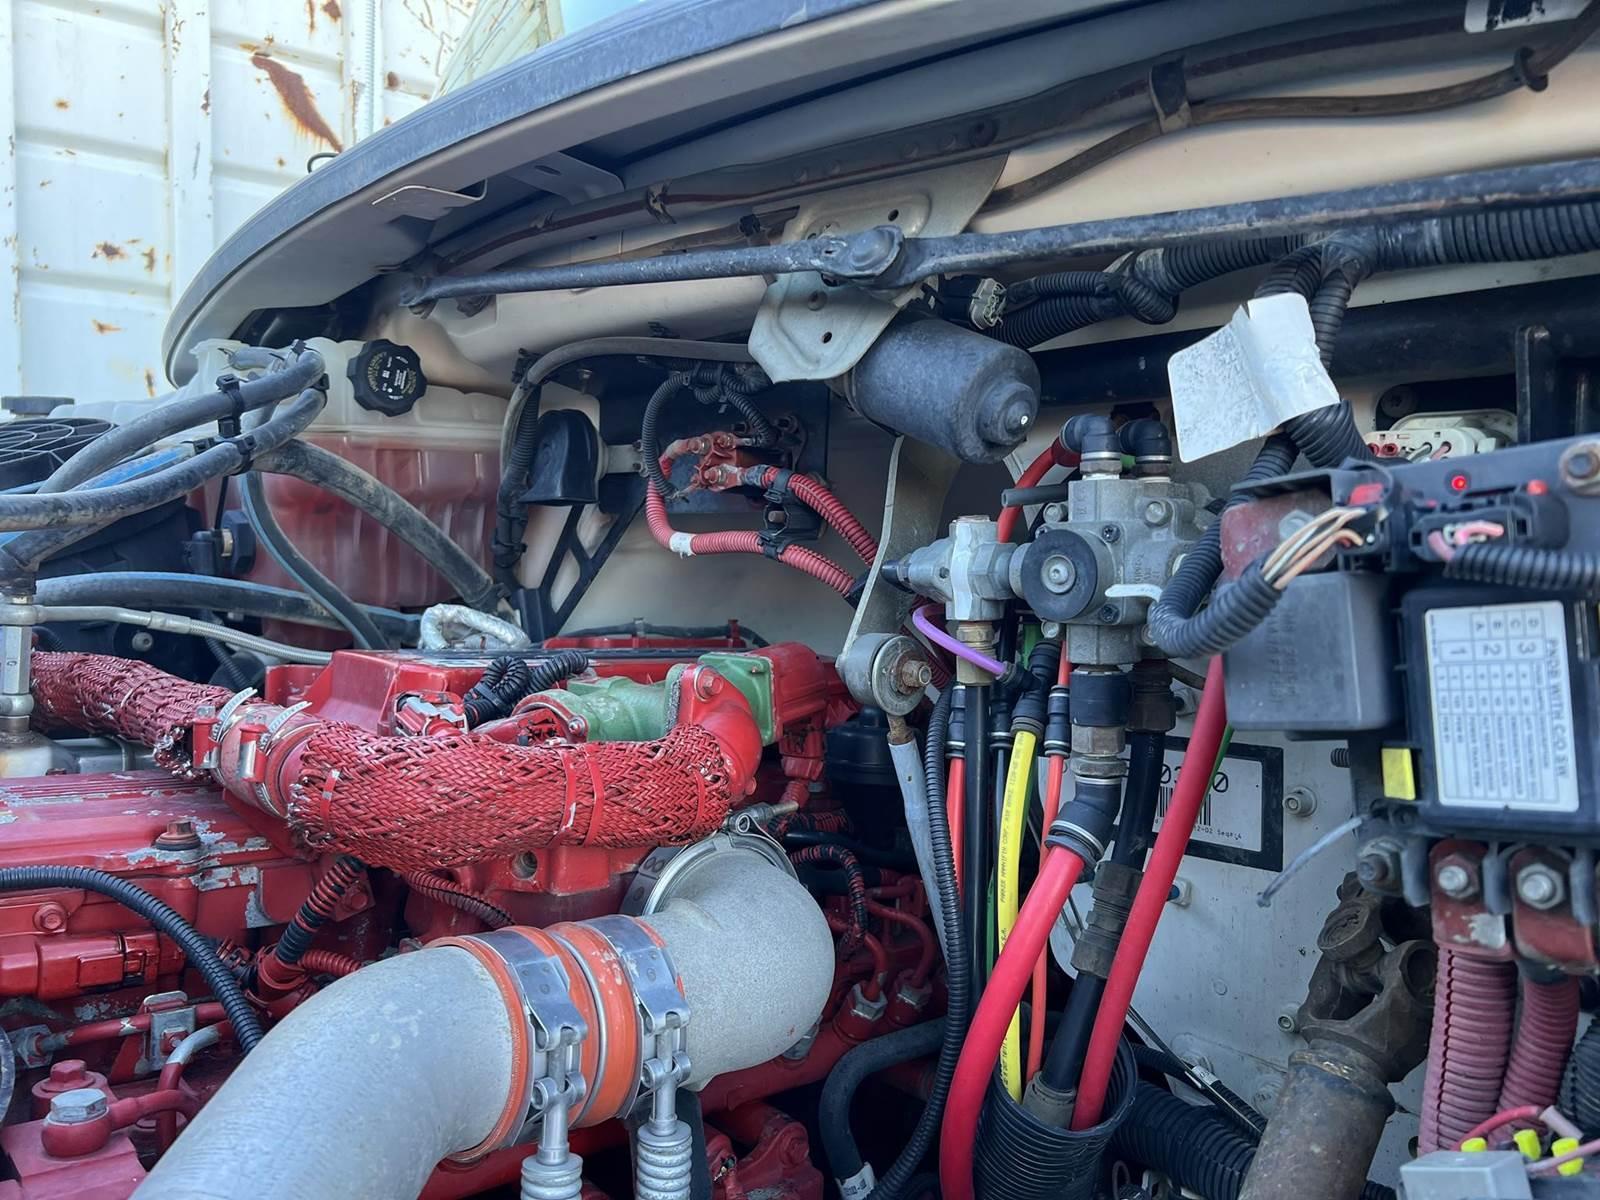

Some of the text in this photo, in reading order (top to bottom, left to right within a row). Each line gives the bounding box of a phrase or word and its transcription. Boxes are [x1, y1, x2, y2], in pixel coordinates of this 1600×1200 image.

[1449, 646, 1467, 655] 1
[1483, 642, 1502, 655] 2
[1517, 641, 1536, 654] 3
[1548, 681, 1564, 720] WITH
